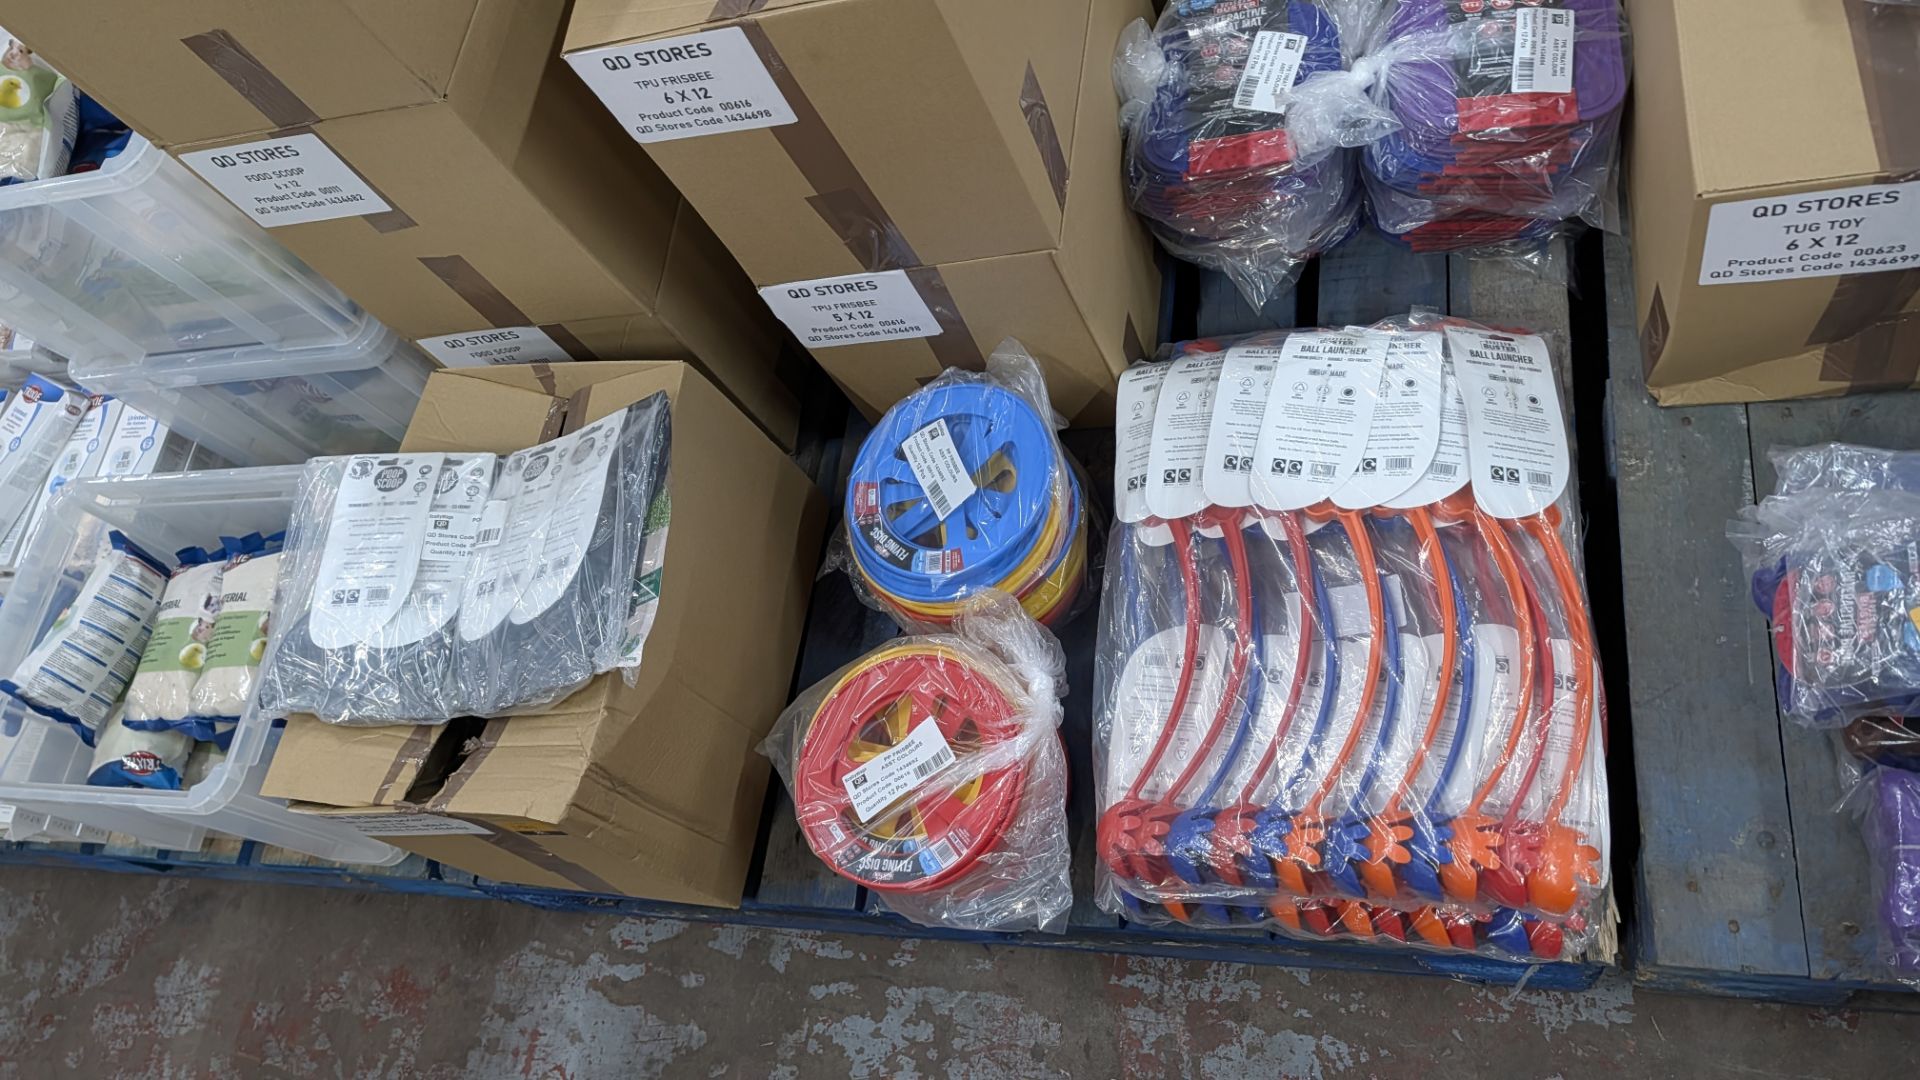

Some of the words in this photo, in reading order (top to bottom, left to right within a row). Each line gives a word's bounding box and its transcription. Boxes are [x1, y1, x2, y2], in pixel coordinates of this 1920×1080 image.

[602, 55, 632, 71] QD
[634, 43, 713, 67] STORES
[634, 76, 659, 90] TPU
[661, 71, 714, 86] FRISBEE
[664, 93, 674, 104] 6
[676, 90, 691, 102] X
[691, 88, 712, 100] 12
[639, 109, 684, 121] Product
[685, 106, 714, 116] Code
[719, 100, 752, 111] 00616
[636, 126, 653, 134] QD
[656, 120, 693, 132] Stores
[695, 118, 723, 127] Code
[725, 110, 772, 123] 1434698
[211, 155, 237, 168] QD
[236, 145, 300, 164] STORES
[244, 172, 273, 183] FOOD
[272, 167, 305, 179] SCOOP
[289, 180, 302, 188] 12
[254, 192, 290, 204] Product
[293, 190, 317, 199] Code
[318, 185, 343, 194] 00111
[255, 207, 271, 215] QD
[272, 204, 301, 213] Stores
[302, 200, 326, 209] Code
[326, 194, 365, 206] 1434682
[1753, 204, 1788, 218] QD
[1796, 191, 1901, 214] STORES
[1783, 223, 1821, 235] TUG
[1827, 217, 1866, 230] TOY
[1786, 239, 1799, 250] 6
[1809, 237, 1826, 249] X
[1835, 234, 1860, 246] 12
[1728, 256, 1794, 267] Product
[1799, 252, 1843, 262] Code
[1854, 245, 1906, 257] 00623
[1710, 270, 1734, 279] QD
[1739, 267, 1795, 277] Stores
[1801, 261, 1844, 272] Code
[1850, 254, 1920, 268] 1434699
[787, 288, 810, 299] QD
[814, 281, 878, 297] STORES
[811, 304, 832, 312] TPU
[834, 300, 878, 310] FRISBEE
[833, 313, 843, 322] 5
[848, 312, 857, 320] X
[858, 310, 875, 319] 12
[811, 325, 849, 333] Product
[879, 319, 906, 327] 00616
[825, 333, 855, 341] Stores
[857, 330, 881, 338] Code
[882, 325, 921, 335] 1434698
[444, 339, 465, 349] QD
[466, 331, 520, 347] STORES
[470, 350, 493, 359] FOOD
[495, 346, 521, 355] SCOOP
[1300, 345, 1320, 353] BALL
[1323, 347, 1368, 355] LAUNCHER
[1469, 349, 1489, 359] BALL
[1491, 352, 1534, 365] LAUNCHER
[382, 468, 403, 479] POOP
[916, 462, 921, 470] 12
[376, 478, 403, 489] SCOOP
[870, 527, 889, 547] DISC
[885, 536, 910, 561] FLYING
[881, 761, 896, 770] ASST
[896, 741, 923, 762] COLOURS
[893, 740, 916, 758] FRISBEE
[853, 792, 862, 800] QD
[862, 781, 880, 793] Stores
[881, 771, 895, 782] Code
[856, 791, 877, 808] Product
[878, 782, 892, 793] Code
[866, 795, 888, 813] Quantity
[888, 788, 895, 796] 12
[896, 782, 908, 792] Pcs
[882, 859, 914, 873] FLYING
